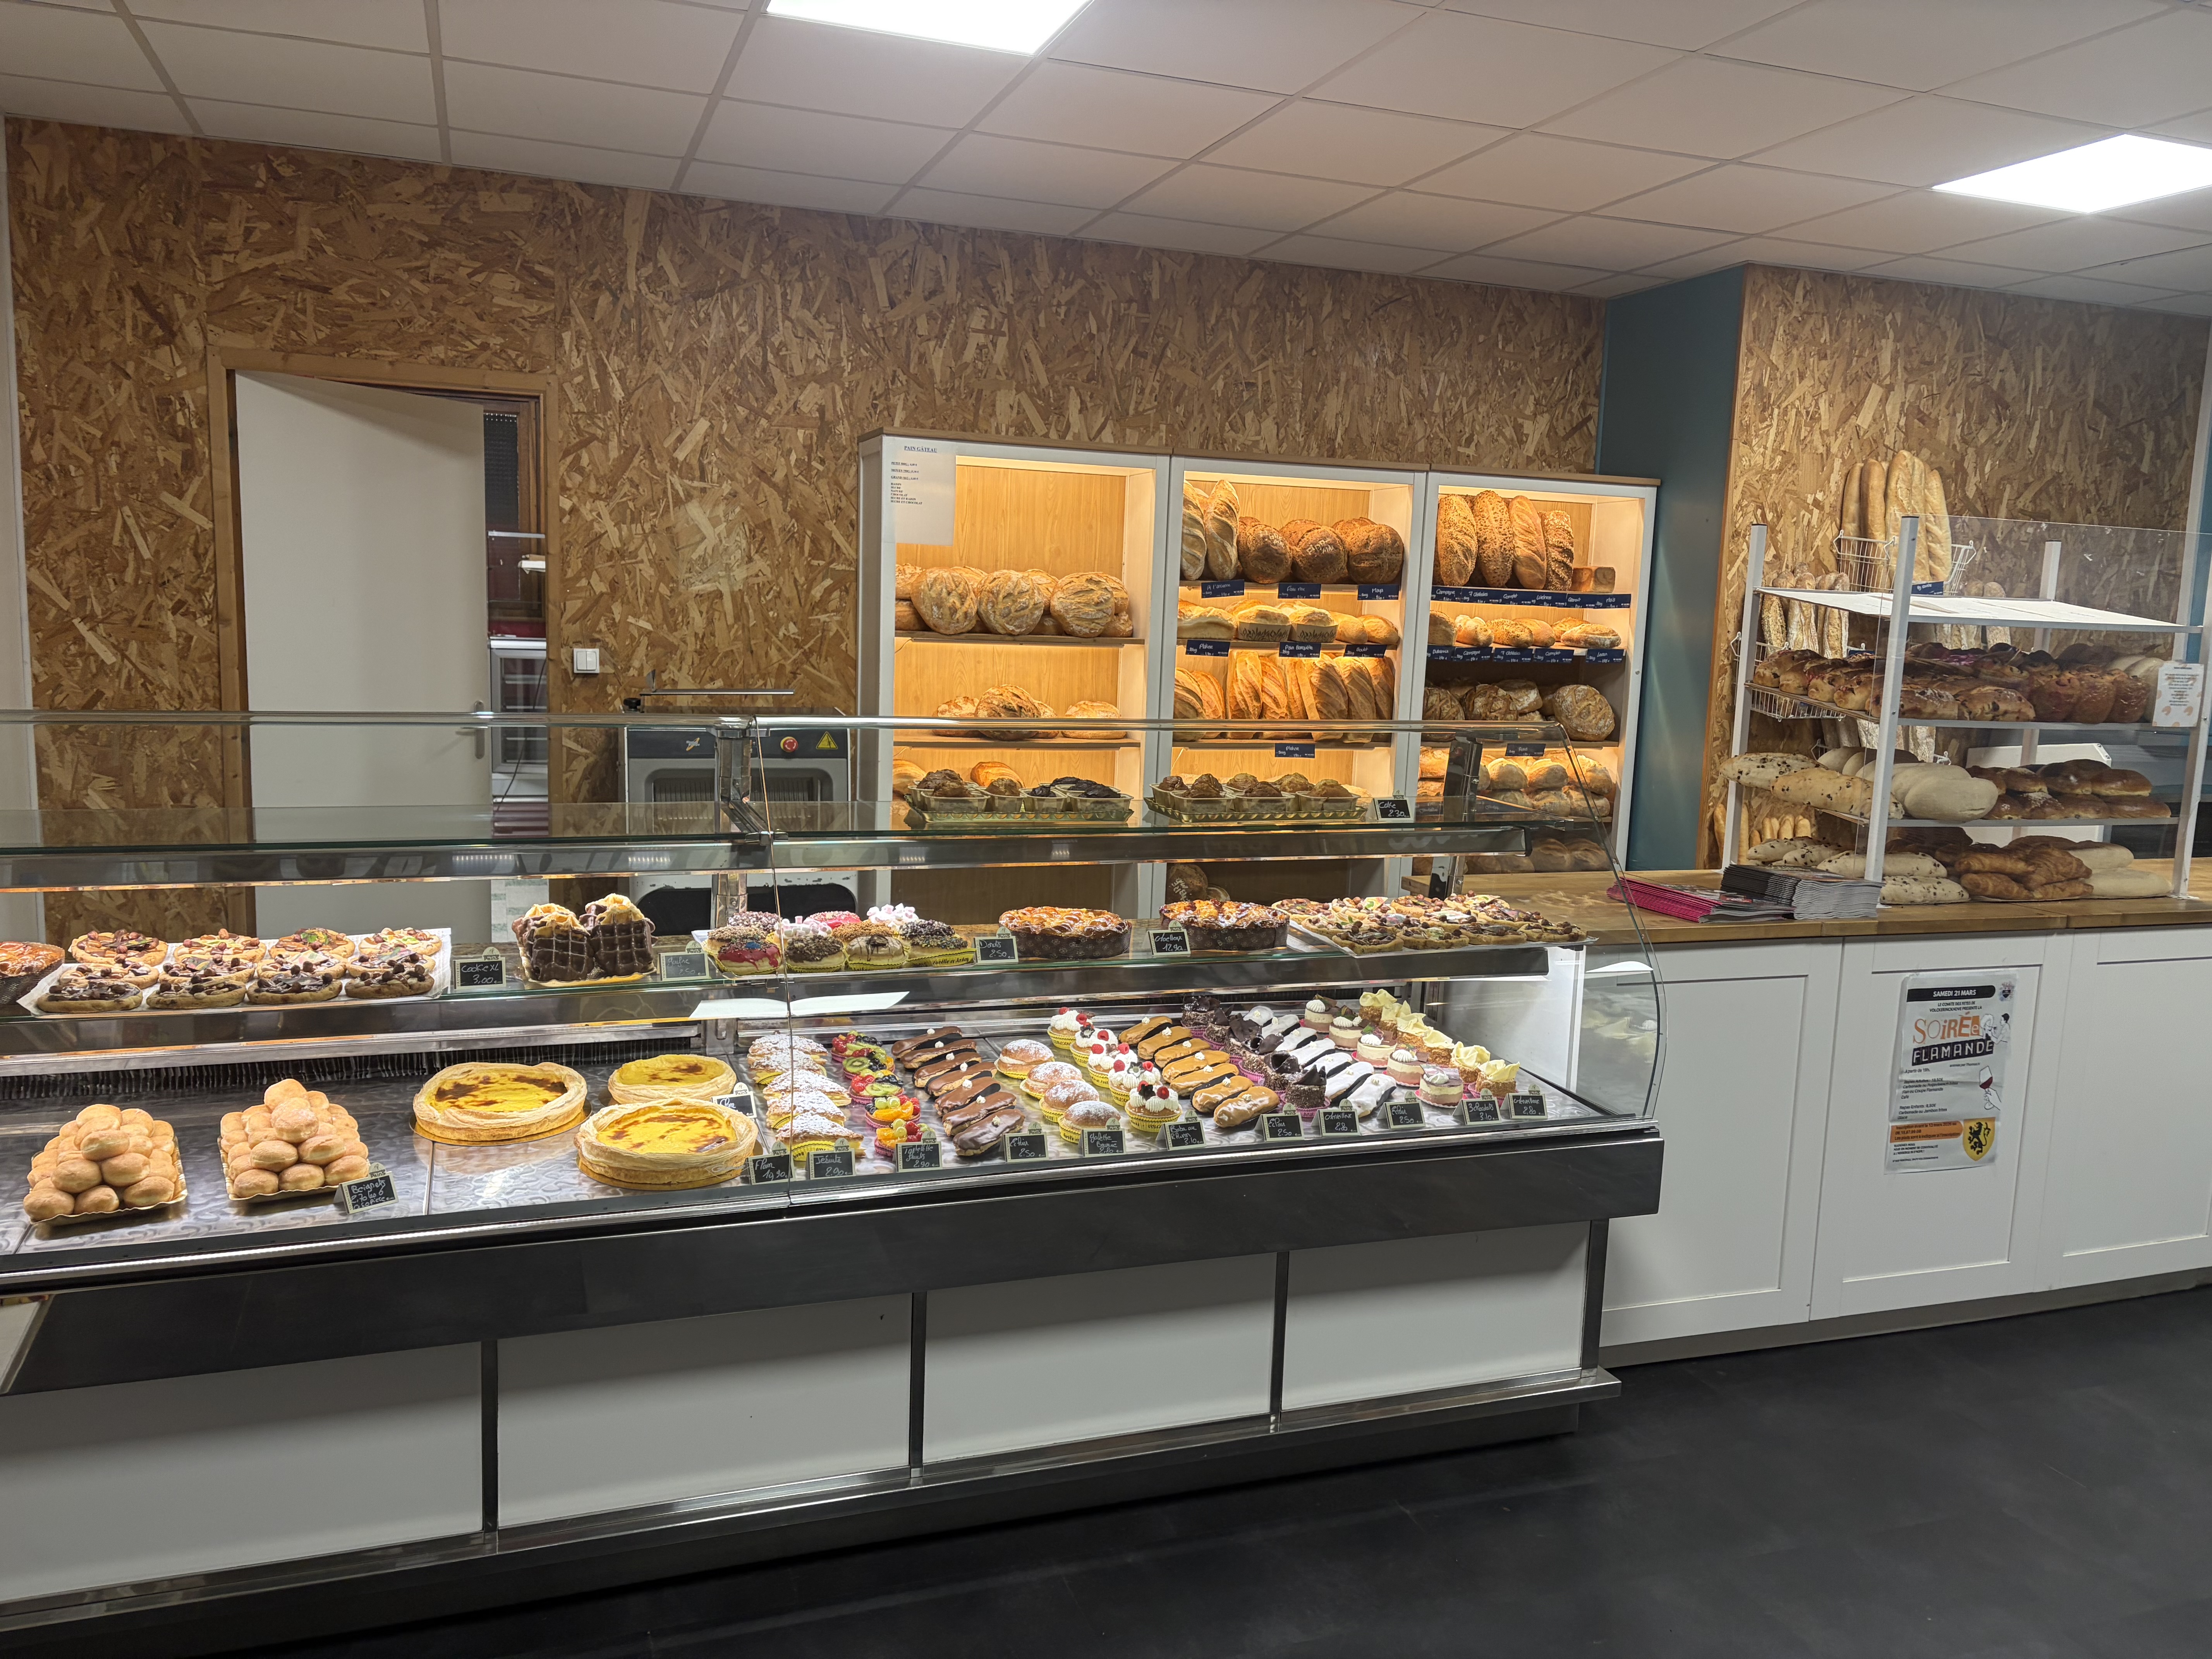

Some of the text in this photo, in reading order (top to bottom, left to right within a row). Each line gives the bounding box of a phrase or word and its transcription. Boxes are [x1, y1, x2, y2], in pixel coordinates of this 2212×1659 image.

[979, 939, 1001, 948] Donuts
[461, 963, 499, 972] Cookie XL
[473, 974, 493, 984] 3,00
[1913, 1040, 1993, 1063] FLAMANDE
[1523, 1106, 1536, 1115] 2,80
[1480, 1112, 1492, 1121] 3.10
[1335, 1122, 1348, 1131] 2,80
[1184, 1137, 1197, 1145] 3.10
[1019, 1148, 1035, 1157] 2.50
[825, 1166, 844, 1176] 2.90
[351, 1178, 386, 1194] Beignets
[351, 1194, 367, 1203] 2,70
